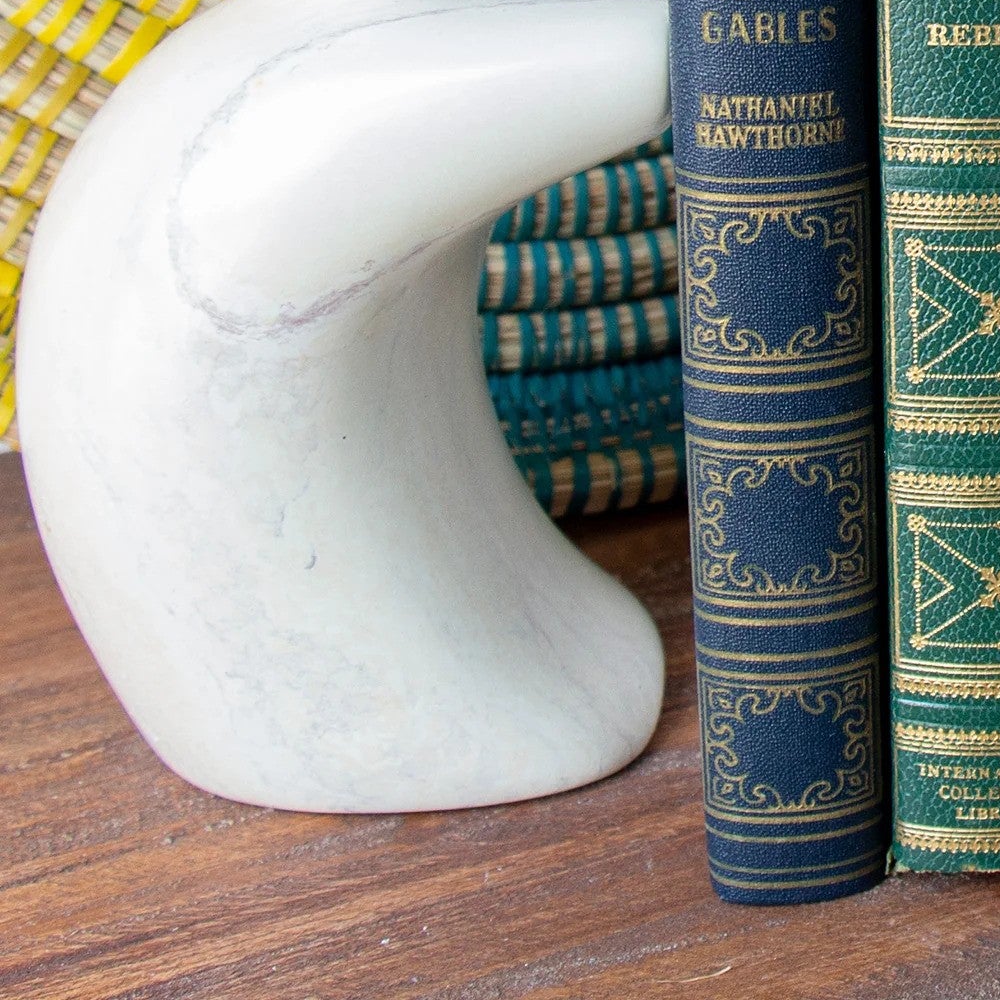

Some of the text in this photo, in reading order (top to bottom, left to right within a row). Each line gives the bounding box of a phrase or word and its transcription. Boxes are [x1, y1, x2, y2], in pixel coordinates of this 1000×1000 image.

[702, 6, 837, 44] GABLES
[700, 90, 840, 121] NATHANIEL
[695, 117, 846, 150] HAWTHORNE
